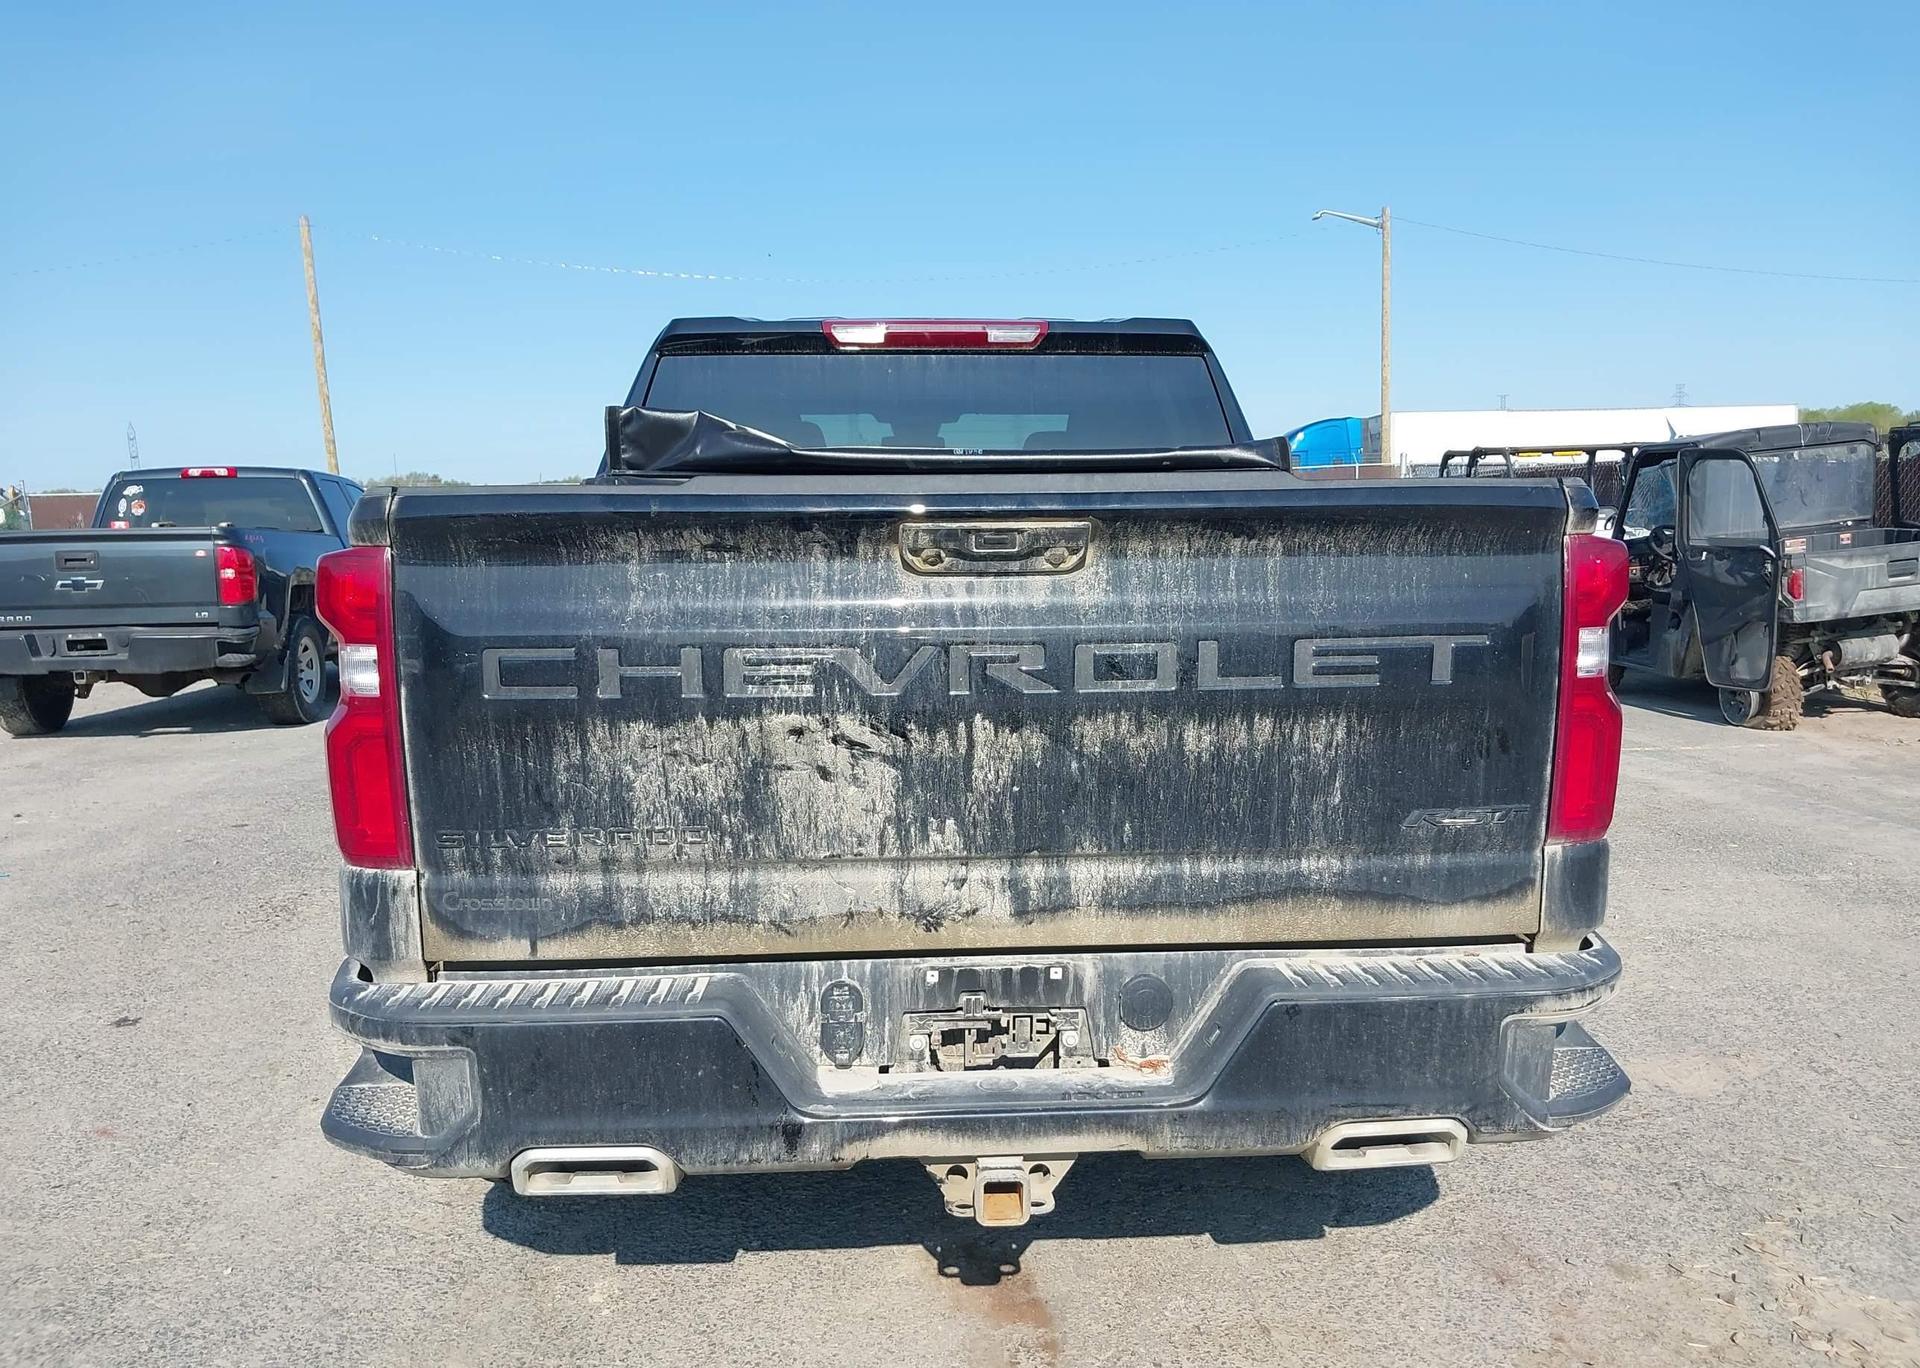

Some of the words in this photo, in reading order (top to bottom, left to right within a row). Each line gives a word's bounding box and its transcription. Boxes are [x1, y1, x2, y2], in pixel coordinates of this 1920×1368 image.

[482, 635, 1490, 699] CHEVROLET
[434, 826, 709, 849] SILVERADO
[442, 891, 554, 912] Crosstown
